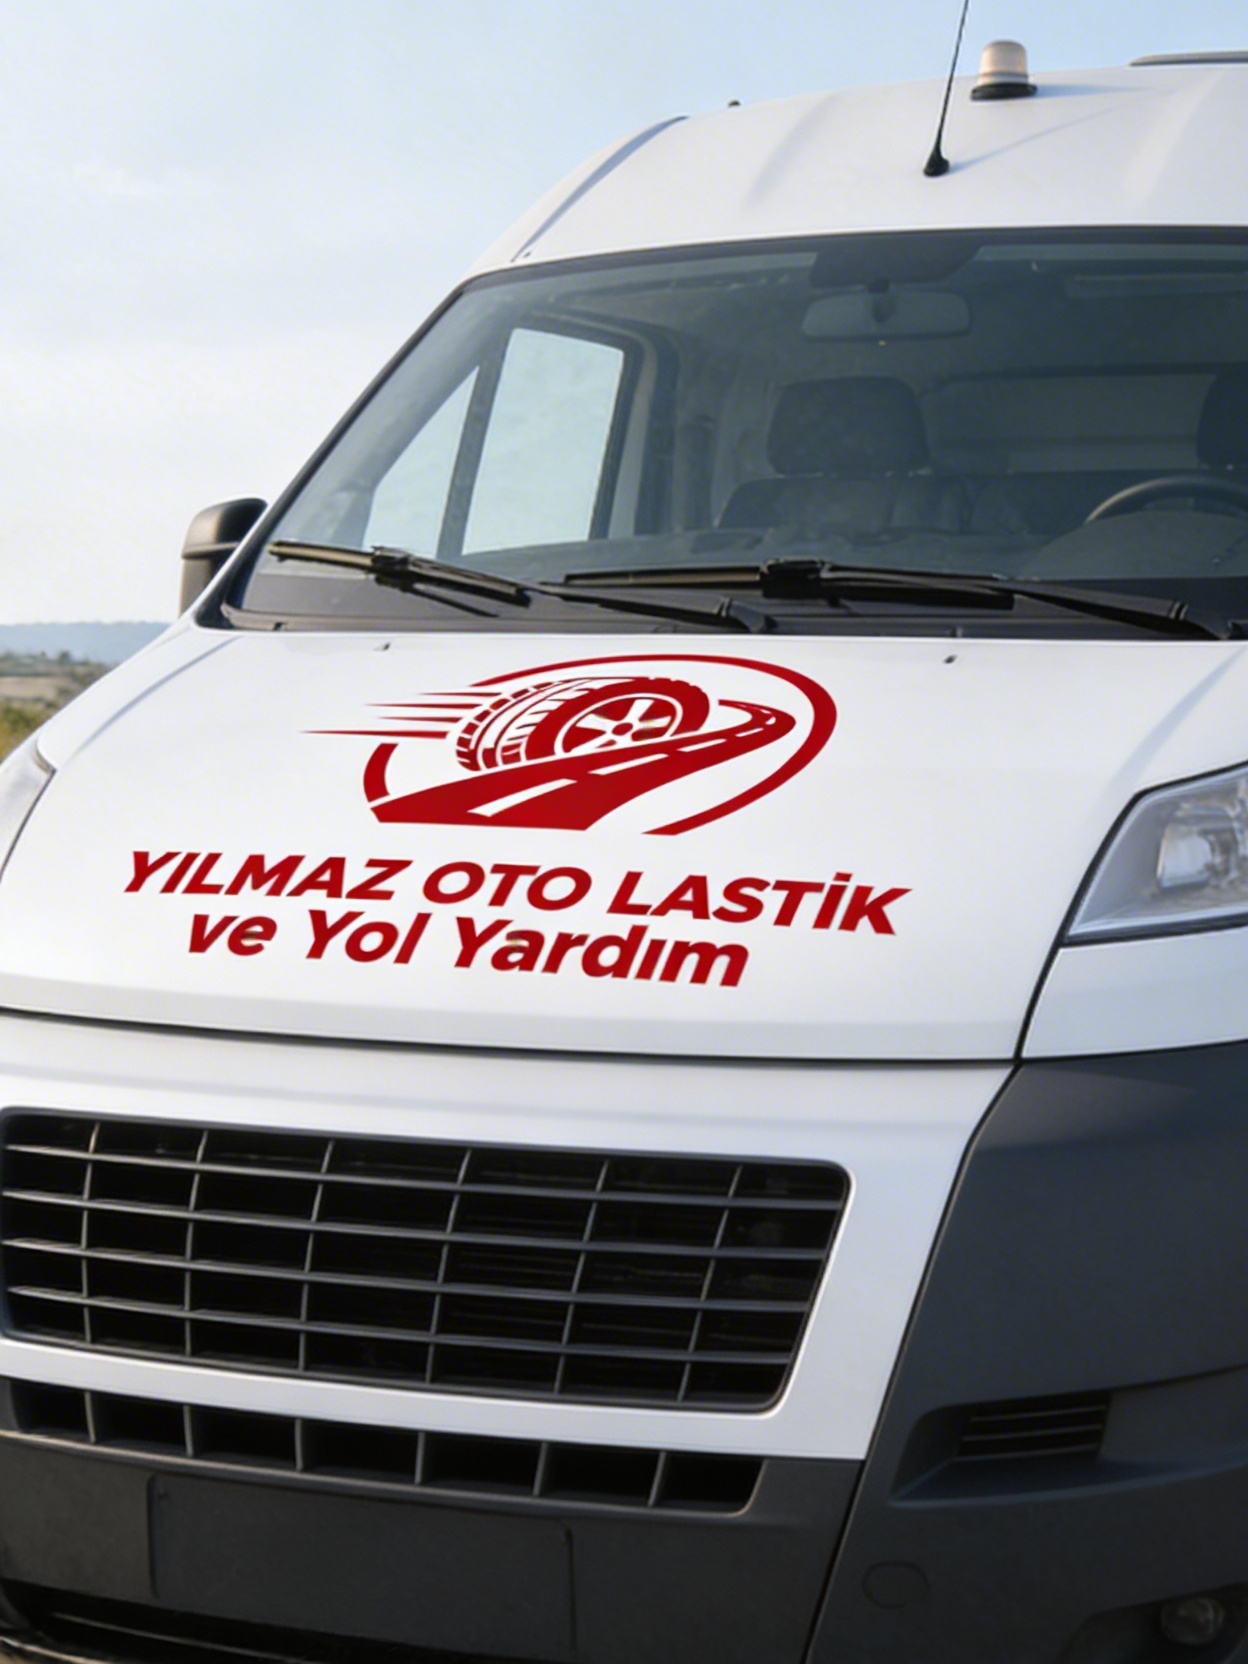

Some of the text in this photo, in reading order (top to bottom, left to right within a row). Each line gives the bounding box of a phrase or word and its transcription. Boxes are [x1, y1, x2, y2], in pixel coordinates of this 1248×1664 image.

[123, 850, 911, 935] YILMAZ OTO LASTİK
[189, 908, 749, 988] ve Yol Yardım
